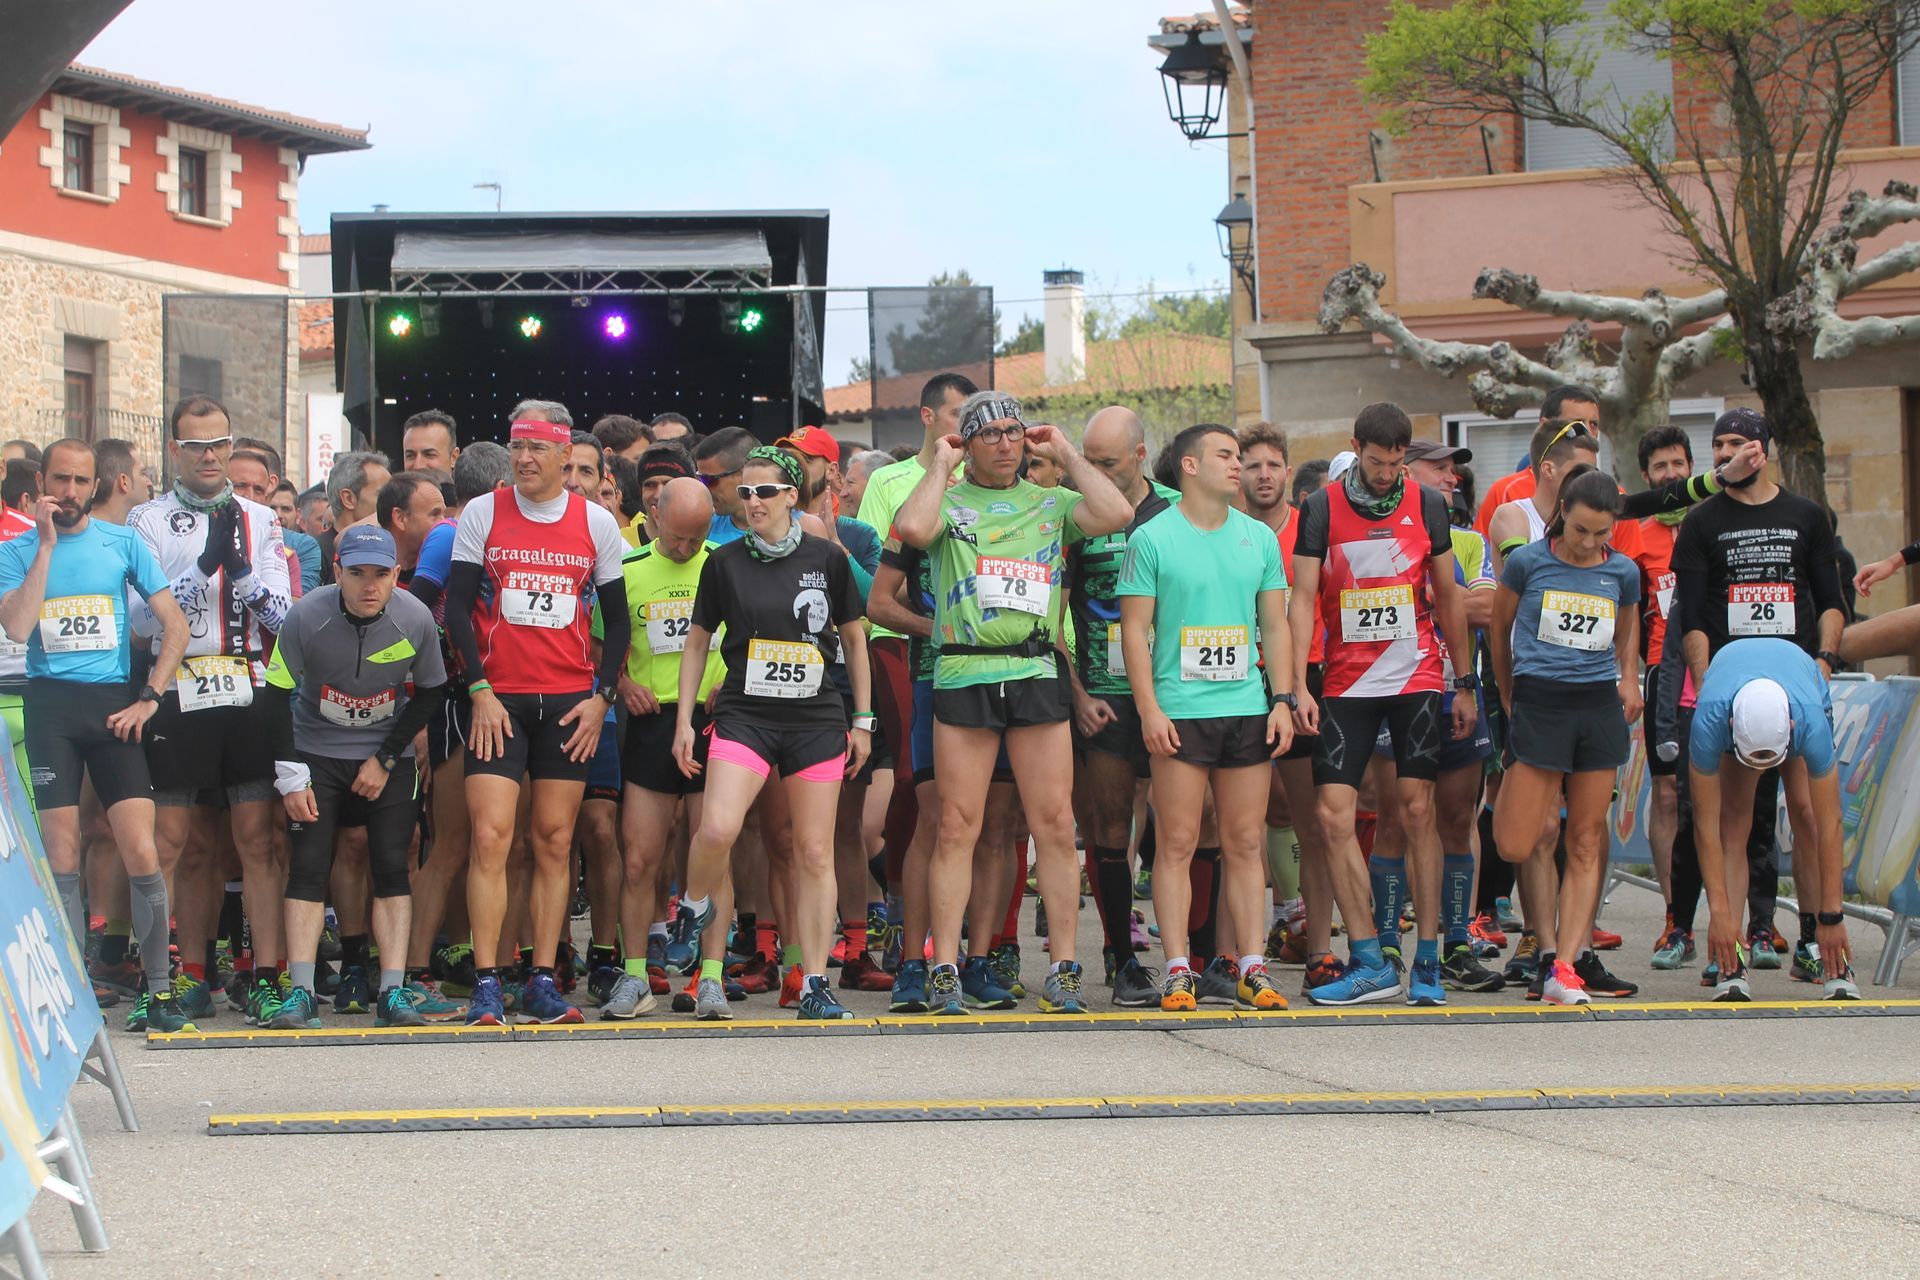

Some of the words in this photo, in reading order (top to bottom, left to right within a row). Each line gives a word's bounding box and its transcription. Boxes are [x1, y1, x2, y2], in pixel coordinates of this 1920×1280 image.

[318, 433, 334, 477] CARNI
[488, 546, 591, 568] Tragaleguas
[982, 559, 1046, 574] DIPUTACIÓN
[982, 566, 1046, 582] BURGOS
[509, 571, 574, 586] DIPUTACIÓN
[803, 571, 825, 580] media
[508, 579, 572, 594] BURGOS
[669, 590, 690, 598] XXXI
[1002, 576, 1027, 597] 78
[1734, 584, 1788, 594] DIPUTACIÓN
[45, 596, 108, 609] DIPUTACIÓN
[527, 591, 553, 612] 73
[1346, 596, 1408, 608] BURGOS
[1734, 593, 1789, 602] BURGOS
[46, 605, 110, 618] BURGOS
[650, 600, 695, 611] DIPUTAC
[1549, 600, 1610, 617] BURGOS
[1750, 602, 1775, 621] 26
[650, 608, 692, 619] BURG
[1358, 606, 1398, 627] 273
[59, 615, 101, 636] 262
[663, 617, 690, 637] 32
[1558, 612, 1599, 635] 327
[1186, 636, 1244, 645] BURGOS
[754, 650, 819, 662] BURGOS
[1199, 646, 1236, 666] 215
[765, 661, 806, 683] 255
[196, 674, 236, 695] 218
[327, 695, 390, 708] BURGOS
[345, 707, 371, 718] 16
